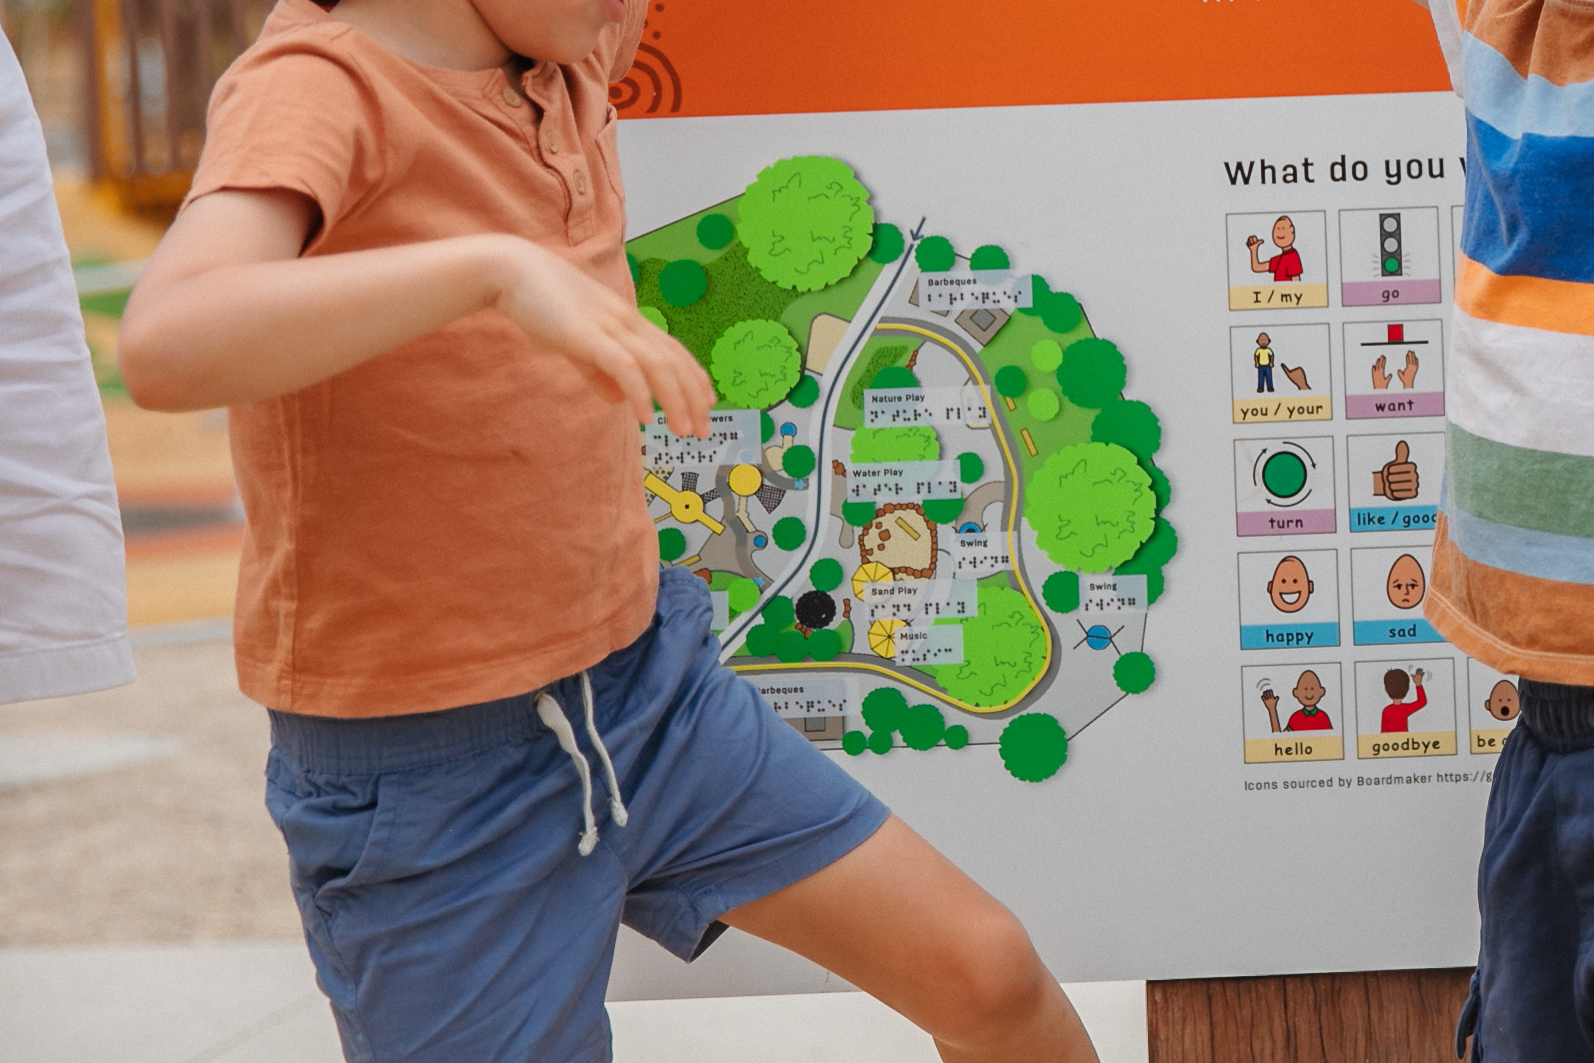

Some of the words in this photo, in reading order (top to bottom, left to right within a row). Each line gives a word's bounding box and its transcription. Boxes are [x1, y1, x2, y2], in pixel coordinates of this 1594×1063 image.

[1223, 157, 1315, 186] What
[1329, 154, 1368, 182] do
[1384, 157, 1445, 186] you
[927, 277, 978, 287] Barbeques
[1253, 291, 1262, 304] I
[1280, 292, 1303, 306] my
[1381, 289, 1400, 303] go
[871, 394, 903, 404] Nature
[905, 393, 926, 404] Play
[1375, 398, 1415, 412] want
[1240, 406, 1268, 420] you
[1287, 403, 1323, 418] your
[852, 469, 882, 478] Water
[883, 468, 904, 478] Play
[1268, 516, 1304, 529] turn
[1357, 512, 1386, 526] like
[960, 538, 988, 550] Swing
[871, 586, 895, 597] Sand
[897, 586, 918, 597] Play
[1089, 582, 1118, 593] Swing
[900, 630, 928, 641] Music
[1265, 629, 1314, 645] happy
[1388, 624, 1417, 638] sad
[758, 686, 804, 695] arbeques
[1372, 739, 1441, 756] goodbye
[1477, 734, 1496, 748] be
[1274, 743, 1313, 756] hello
[1244, 780, 1278, 791] Icons
[1282, 776, 1334, 789] sourced
[1338, 776, 1352, 788] by
[1357, 773, 1432, 787] Boardmaker
